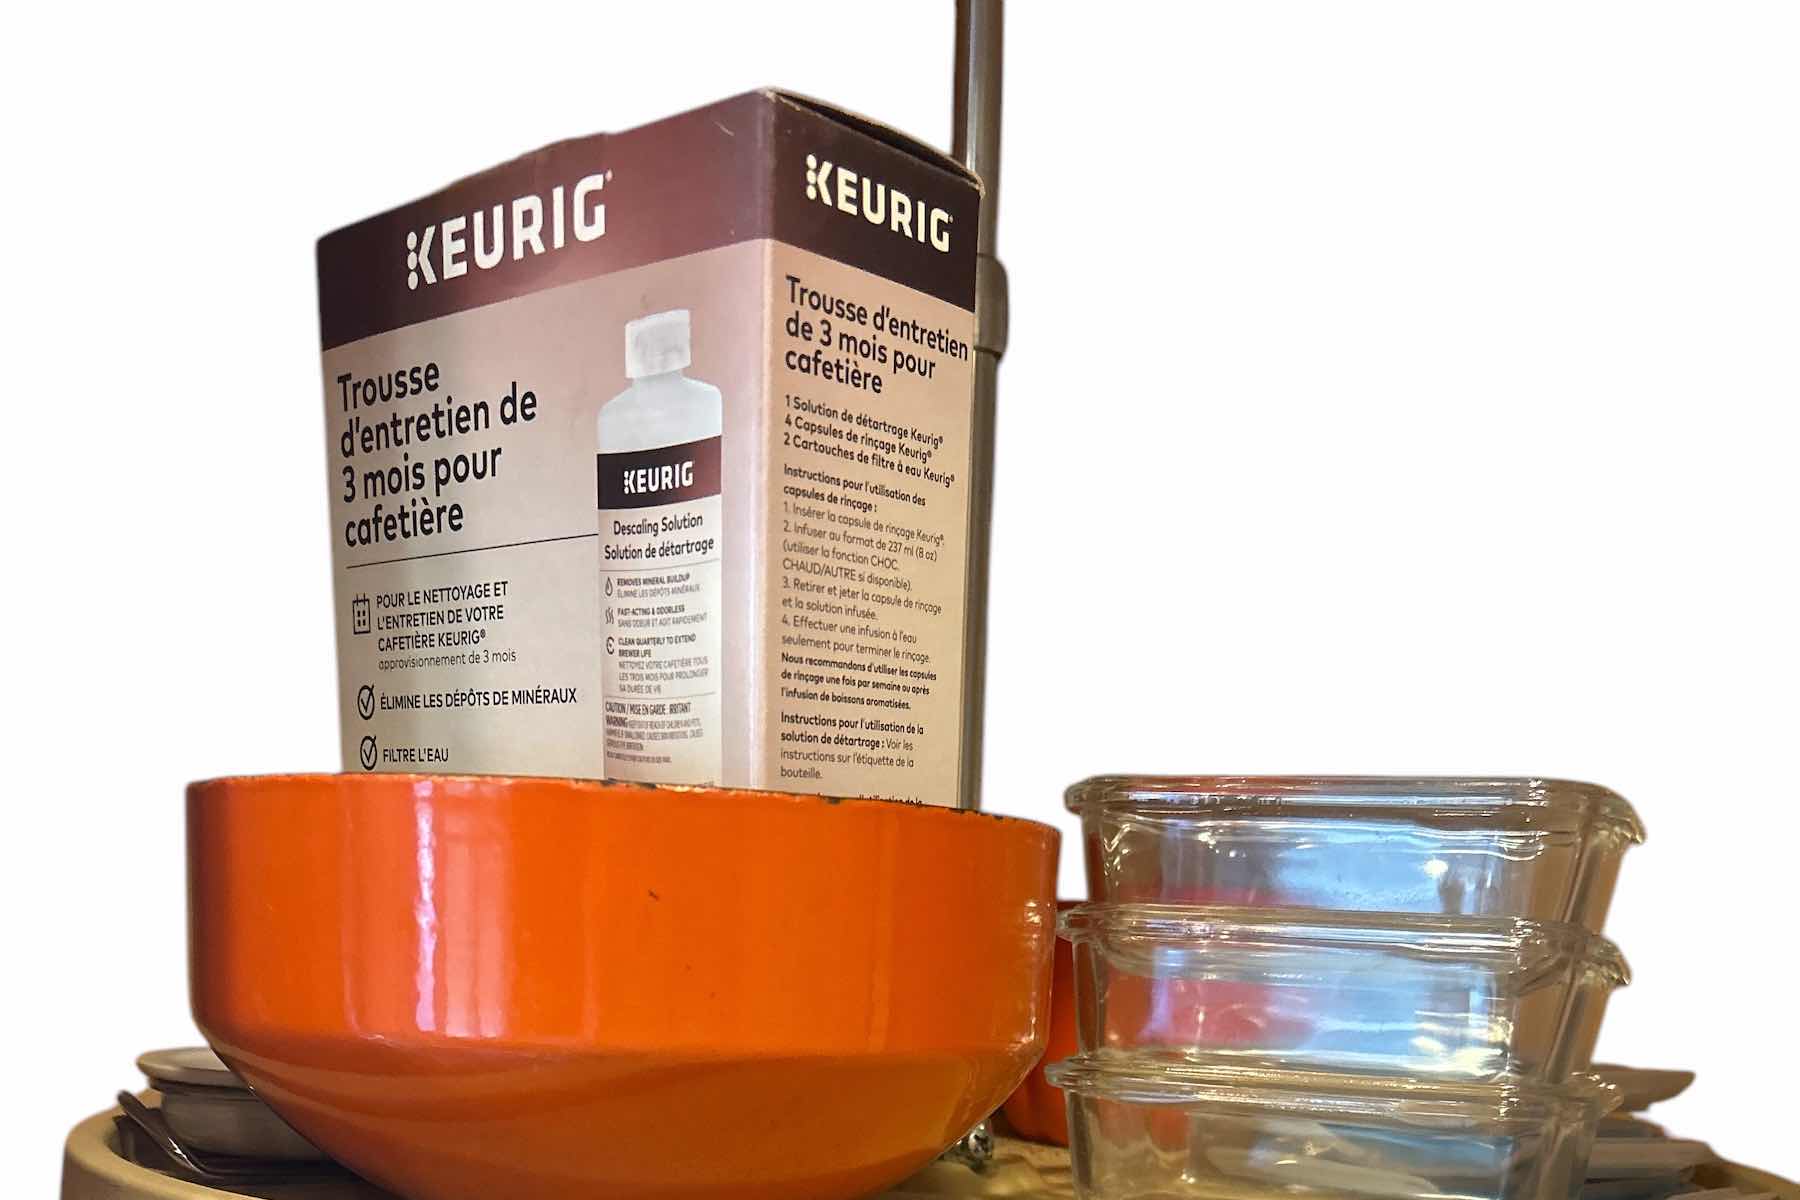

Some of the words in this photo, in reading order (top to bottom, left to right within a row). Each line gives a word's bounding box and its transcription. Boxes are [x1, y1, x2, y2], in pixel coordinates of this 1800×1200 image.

[806, 153, 951, 254] KEURIG
[407, 173, 605, 290] KEURIG
[786, 274, 868, 325] Trousse
[873, 304, 968, 360] d'entretien
[786, 311, 813, 341] de
[820, 319, 832, 346] 3
[839, 332, 887, 364] mois
[893, 350, 936, 378] pour
[786, 349, 882, 393] cafetière
[338, 363, 439, 411] Trousse
[341, 396, 490, 458] d'entretien
[500, 381, 537, 425] de
[785, 395, 790, 407] 1
[793, 397, 838, 419] Solution
[841, 409, 853, 422] de
[856, 413, 908, 439] détartrage
[785, 414, 792, 426] 4
[795, 416, 843, 439] Capsules
[846, 430, 858, 442] de
[861, 433, 896, 454] rinçage
[784, 433, 790, 446] 2
[793, 435, 854, 460] Cartouches
[857, 451, 868, 464] de
[872, 454, 895, 470] filtre
[898, 460, 902, 472] à
[905, 466, 921, 477] eau
[342, 466, 355, 503] 3
[364, 452, 425, 499] mois
[435, 448, 502, 496] pour
[624, 461, 693, 494] KEURIG
[784, 464, 840, 486] Instructions
[843, 480, 863, 490] pour
[865, 482, 910, 502] l'utilisation
[912, 493, 925, 506] des
[784, 485, 824, 502] capsules
[827, 492, 838, 503] de
[841, 495, 872, 512] rinçage
[345, 497, 463, 547] cafetière
[614, 519, 659, 536] Descaling
[662, 513, 703, 532] Solution
[793, 503, 824, 520] Insérer
[828, 511, 835, 522] la
[839, 516, 871, 529] capsule
[873, 520, 883, 531] de
[886, 524, 914, 539] rinçage
[605, 544, 642, 560] Solution
[645, 543, 656, 558] de
[659, 538, 714, 557] détartrage
[794, 522, 825, 538] Infuser
[829, 531, 840, 541] au
[843, 532, 873, 548] format
[876, 540, 886, 551] de
[888, 541, 902, 553] 237
[904, 545, 913, 556] ml
[916, 546, 923, 559] (8
[822, 545, 830, 557] la
[832, 548, 868, 565] fonction
[783, 559, 856, 581] CHAUD/AUTRE
[858, 572, 865, 581] si
[377, 593, 405, 608] POUR
[408, 591, 420, 606] LE
[424, 584, 491, 604] NETTOYAGE
[494, 581, 508, 596] ET
[782, 598, 792, 608] et
[795, 599, 803, 609] la
[806, 600, 842, 614] solution
[794, 579, 825, 594] Retirer
[828, 584, 837, 595] et
[839, 586, 859, 600] jeter
[862, 589, 869, 600] la
[872, 592, 901, 605] capsule
[904, 597, 913, 608] de
[915, 599, 942, 615] rinçage
[378, 610, 445, 630] L'ENTRETIEN
[448, 608, 463, 623] DE
[466, 605, 504, 622] VOTRE
[793, 616, 837, 631] Effectuer
[840, 624, 855, 635] une
[858, 626, 890, 639] infusion
[892, 630, 897, 640] à
[378, 631, 435, 651] CAFETIÈRE
[782, 635, 830, 649] seulement
[833, 642, 853, 653] pour
[856, 644, 891, 657] terminer
[894, 648, 900, 658] le
[379, 654, 466, 671] approvisionnement
[469, 651, 480, 664] de
[483, 650, 489, 663] 3
[492, 649, 516, 663] mois
[782, 653, 803, 664] Nous
[805, 657, 865, 672] recommandons
[900, 668, 908, 677] les
[910, 670, 936, 681] capsules
[781, 670, 791, 679] de
[794, 672, 823, 685] rinçage
[826, 676, 840, 684] une
[842, 675, 855, 686] fois
[858, 679, 870, 688] par
[872, 680, 900, 691] semaine
[912, 686, 929, 696] après
[381, 696, 420, 710] ÉLIMINE
[423, 694, 443, 708] LES
[446, 689, 489, 707] DÉPÔTS
[493, 691, 509, 705] DE
[512, 685, 577, 704] MINÉRAUX
[781, 688, 818, 700] l'infusion
[820, 692, 829, 701] de
[832, 693, 864, 706] boissons
[781, 712, 836, 728] Instructions
[839, 719, 858, 729] pour
[861, 720, 904, 733] l'utilisation
[907, 724, 915, 734] de
[917, 725, 923, 735] la
[781, 731, 818, 743] solution
[821, 733, 831, 744] de
[834, 735, 880, 750] détartrage
[886, 739, 901, 750] Voir
[903, 741, 913, 751] les
[383, 748, 415, 762] FILTRE
[418, 748, 449, 762] L'EAU
[781, 749, 835, 763] instructions
[837, 754, 850, 763] sur
[853, 752, 893, 768] l'étiquette
[896, 757, 905, 767] de
[907, 759, 913, 767] la
